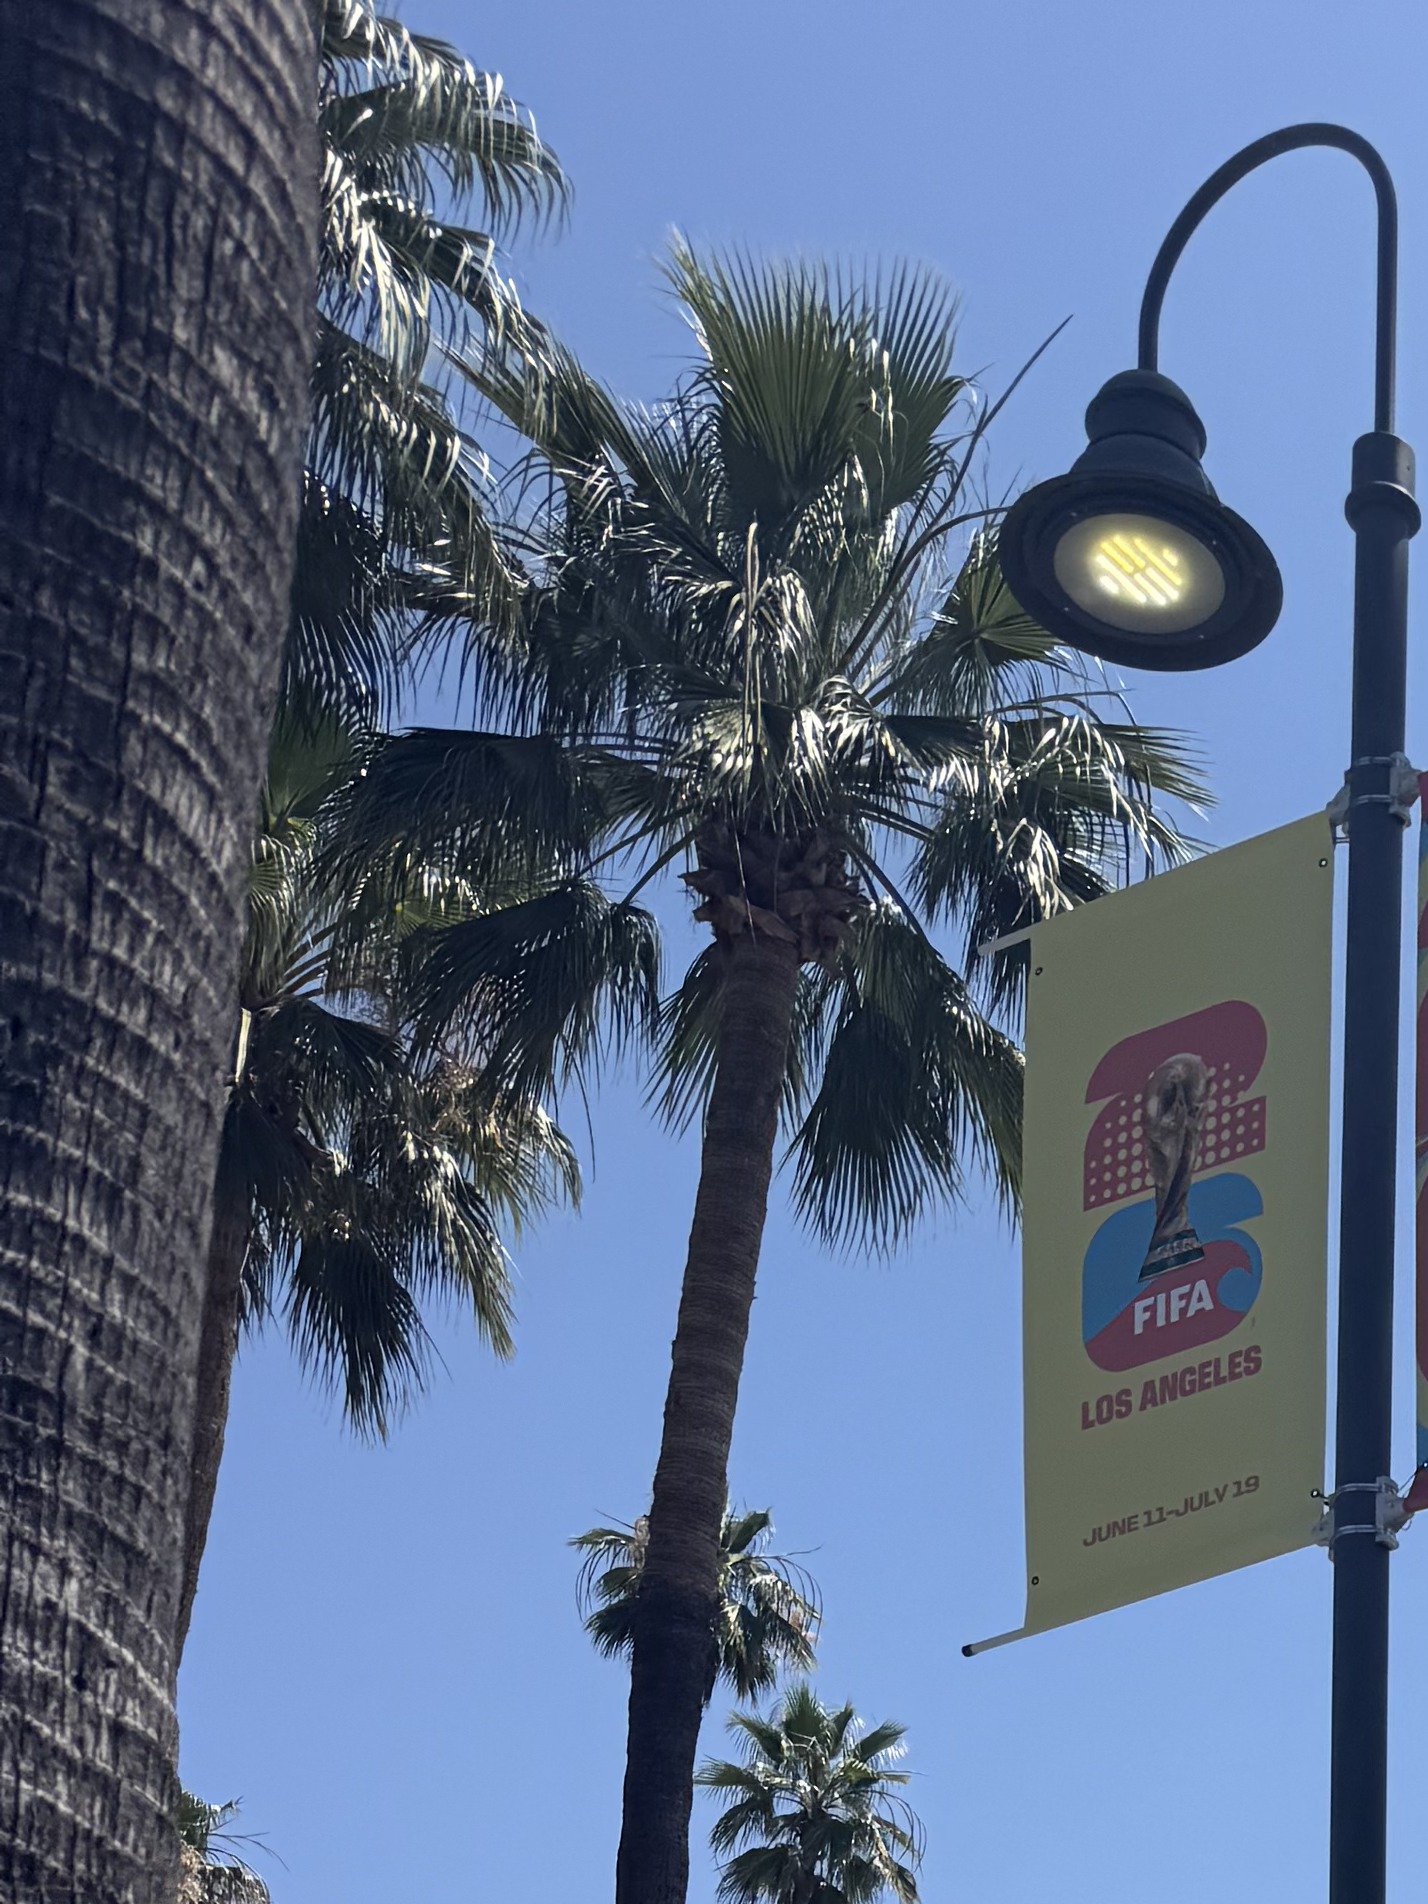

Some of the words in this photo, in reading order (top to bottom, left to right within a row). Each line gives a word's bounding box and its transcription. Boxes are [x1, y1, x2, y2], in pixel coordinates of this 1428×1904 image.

[1133, 1279, 1214, 1336] FIFA
[1080, 1388, 1133, 1431] LOS
[1138, 1343, 1263, 1410] ANGELES
[1082, 1513, 1139, 1548] JUNE
[1142, 1485, 1226, 1528] 11-JULY
[1232, 1475, 1261, 1499] 19
